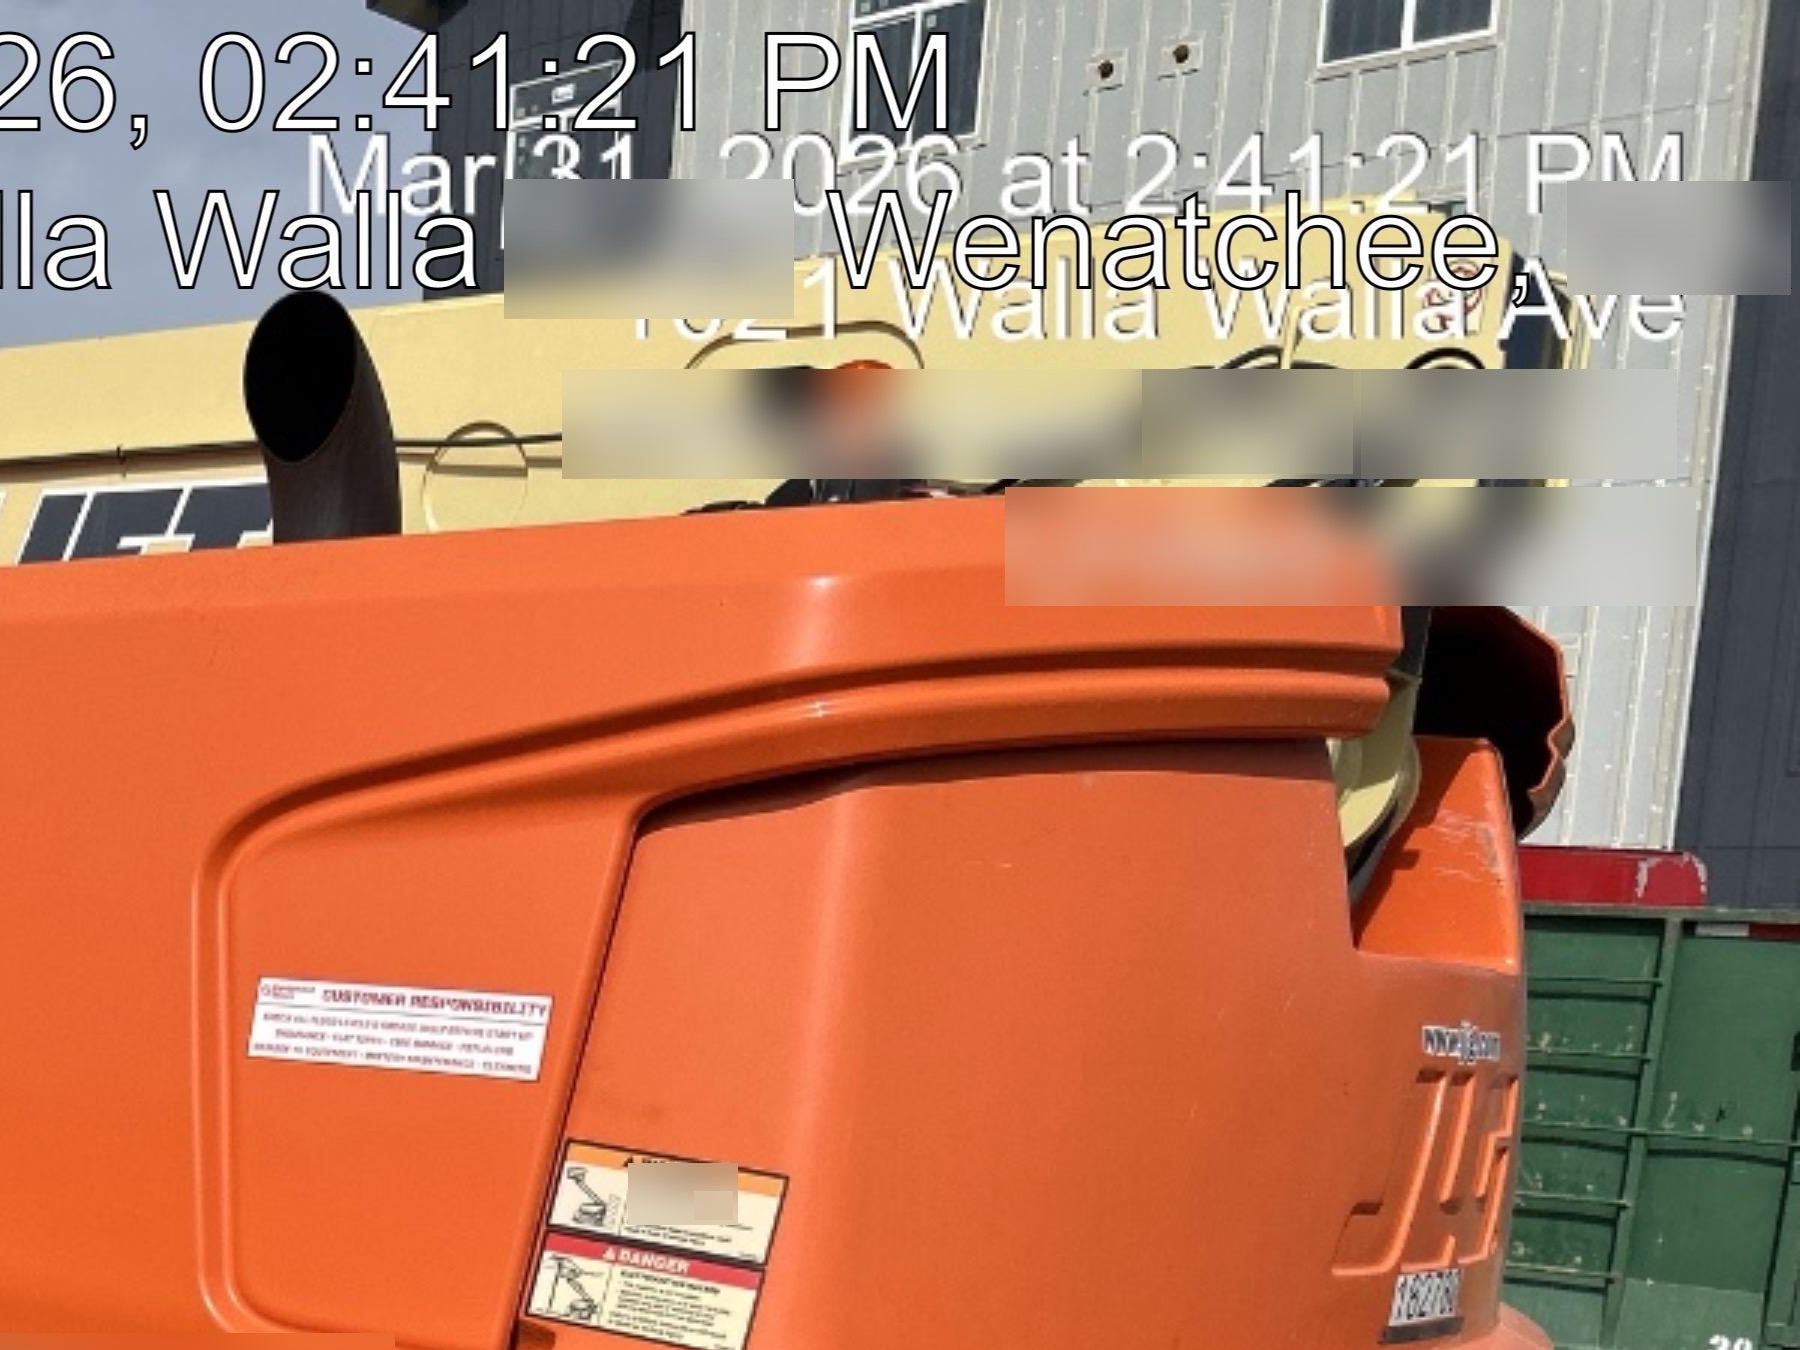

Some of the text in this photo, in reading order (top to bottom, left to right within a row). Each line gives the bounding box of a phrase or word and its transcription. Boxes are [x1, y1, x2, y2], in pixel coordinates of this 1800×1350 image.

[321, 988, 406, 1008] CUSTOMER
[409, 995, 548, 1018] RESPONSIBILITY
[617, 1247, 690, 1276] DANGER
